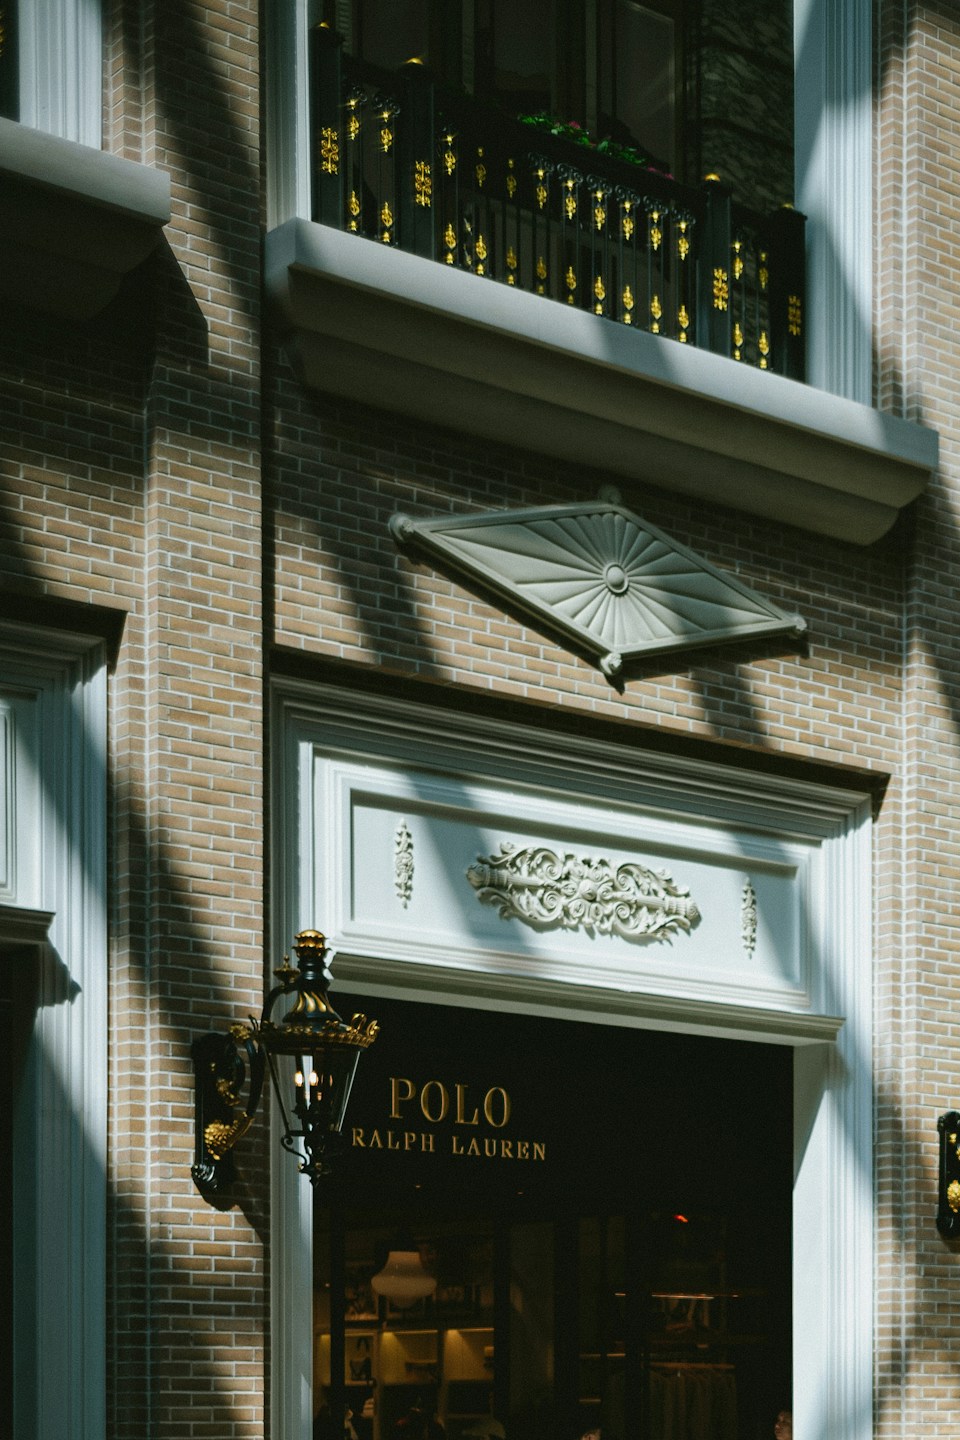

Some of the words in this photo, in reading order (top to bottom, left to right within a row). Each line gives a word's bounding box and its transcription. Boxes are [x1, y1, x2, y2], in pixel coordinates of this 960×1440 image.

[389, 1077, 511, 1128] POLO
[351, 1127, 435, 1152] RALPH
[452, 1135, 546, 1161] LAUREN
